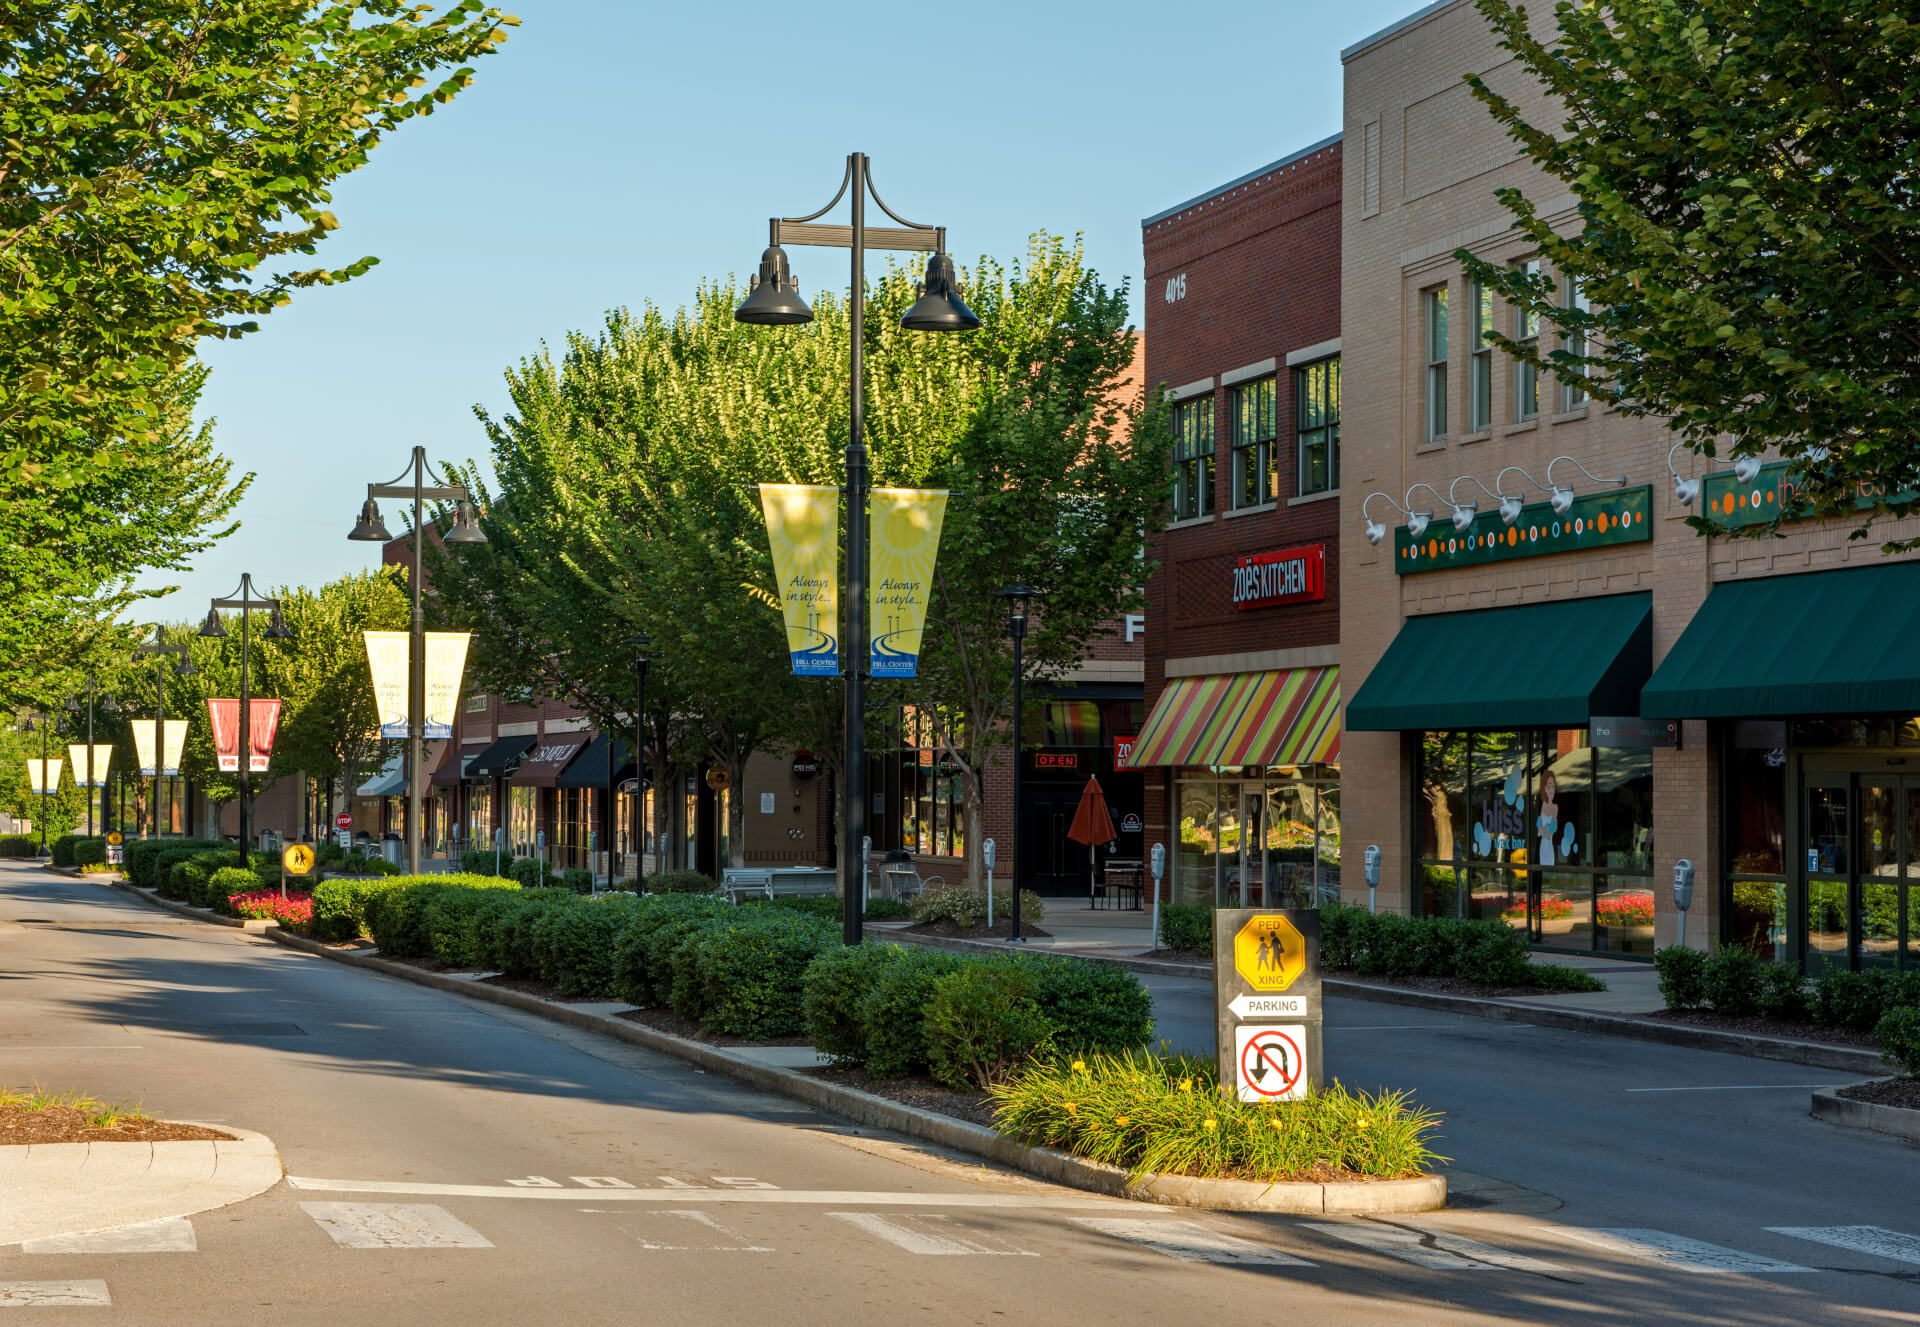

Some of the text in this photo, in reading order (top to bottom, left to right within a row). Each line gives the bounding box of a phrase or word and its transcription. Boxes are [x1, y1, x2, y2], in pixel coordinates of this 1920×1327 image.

[1165, 273, 1187, 305] 4015
[1261, 558, 1306, 598] KITCHEN
[789, 575, 829, 596] Always
[879, 578, 921, 597] Always
[786, 592, 799, 602] in
[876, 595, 887, 605] in
[796, 658, 837, 667] HILL CENTER
[873, 661, 914, 669] HILL CENTER
[1039, 756, 1074, 766] OPEN
[337, 817, 352, 825] STOP
[1482, 799, 1524, 835] bliss
[1494, 835, 1526, 850] wax bar
[1258, 920, 1281, 930] PED
[1258, 975, 1284, 985] XING
[1249, 1000, 1298, 1011] PARKING
